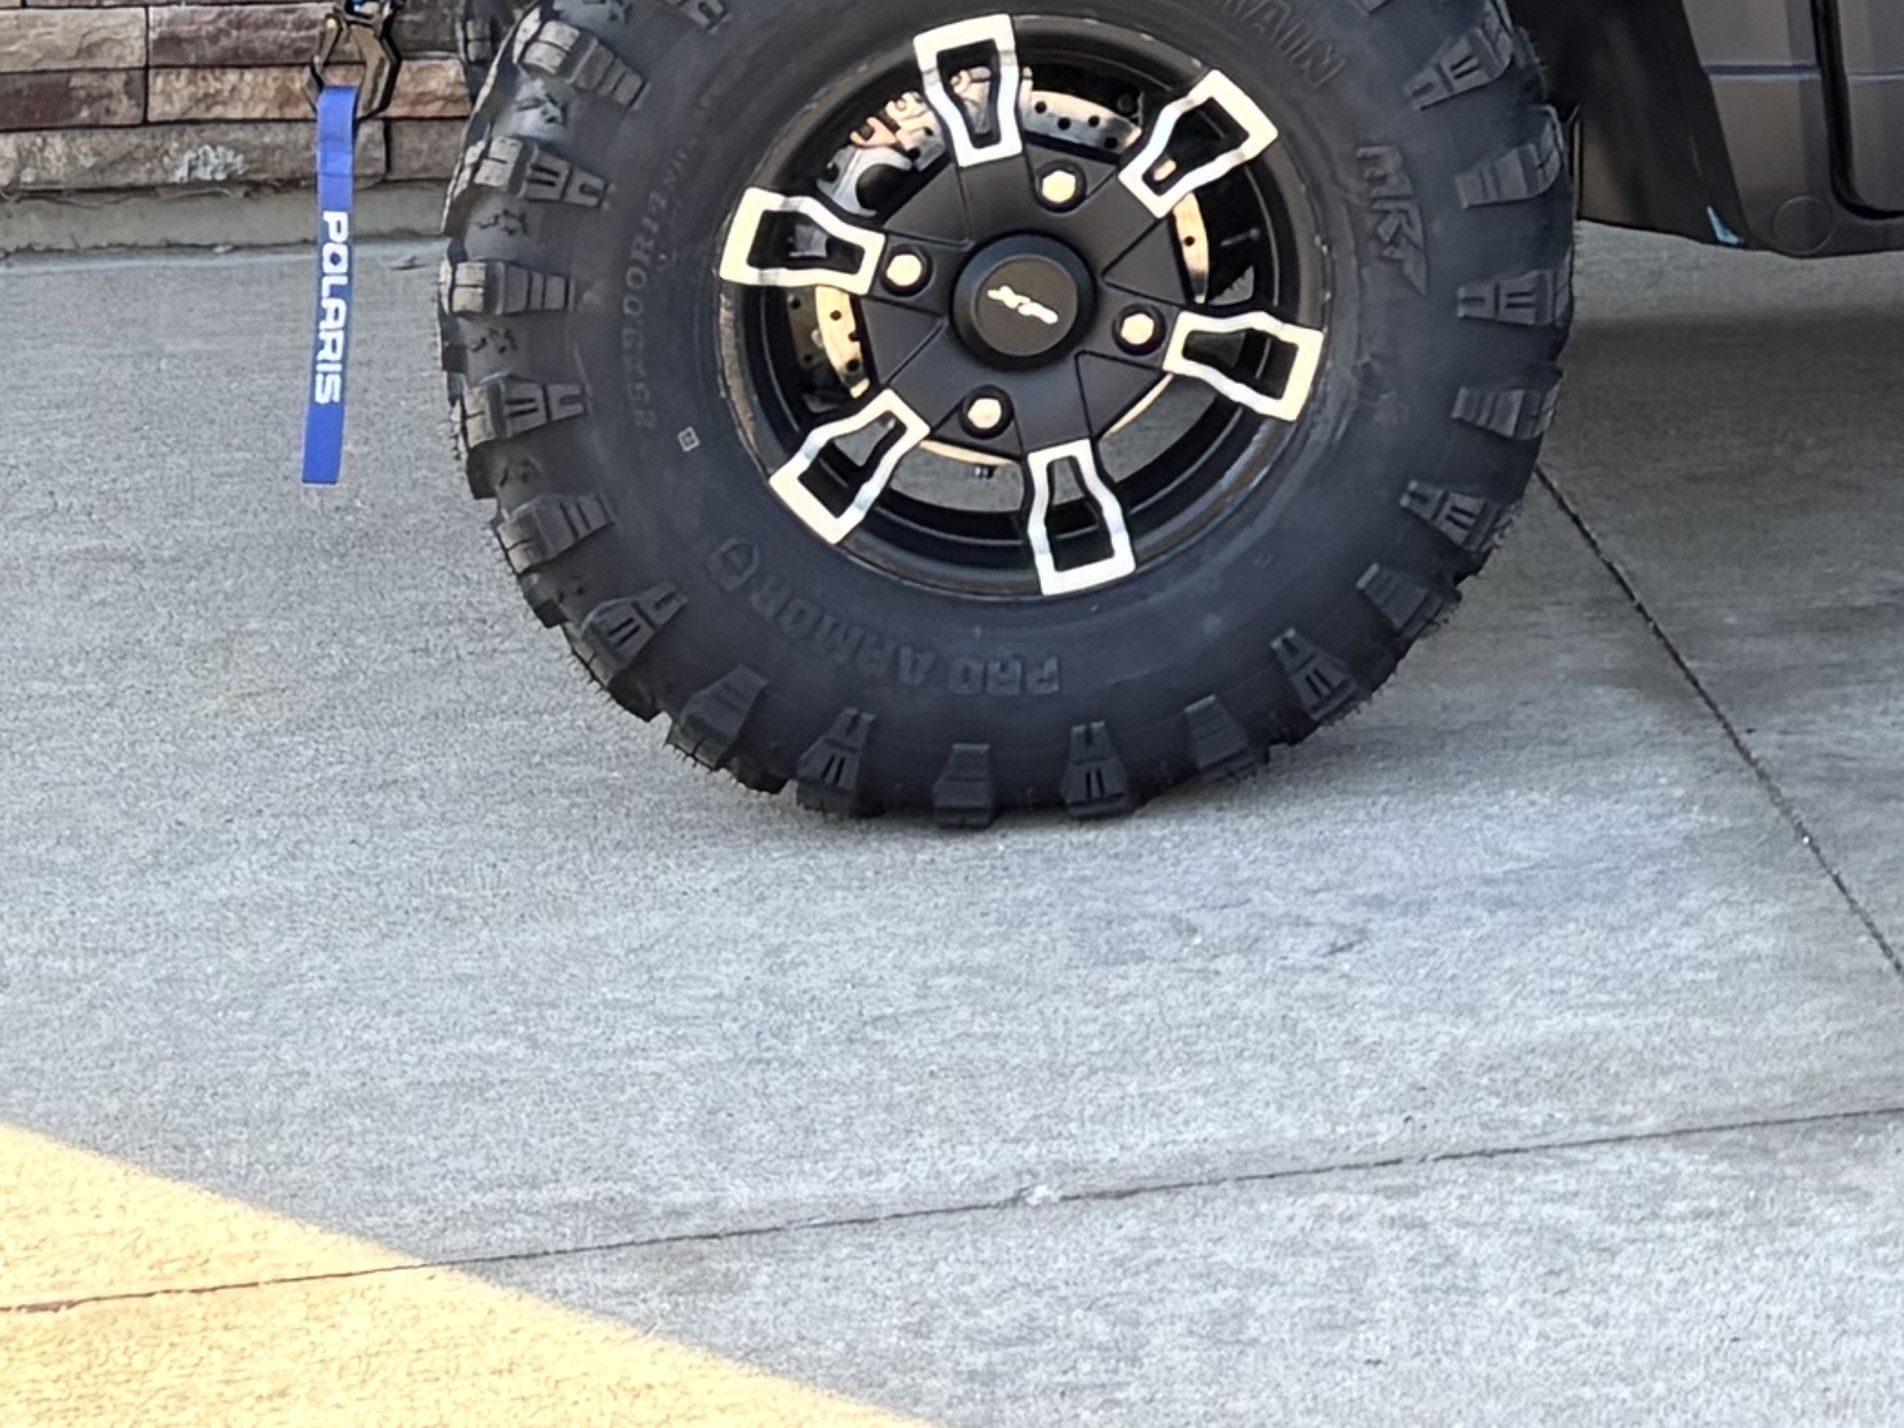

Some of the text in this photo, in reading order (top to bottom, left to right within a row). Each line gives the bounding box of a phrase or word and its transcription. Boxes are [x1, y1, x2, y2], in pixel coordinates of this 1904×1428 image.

[315, 210, 350, 404] POLARIS
[748, 573, 1061, 698] PRO ARMOR
